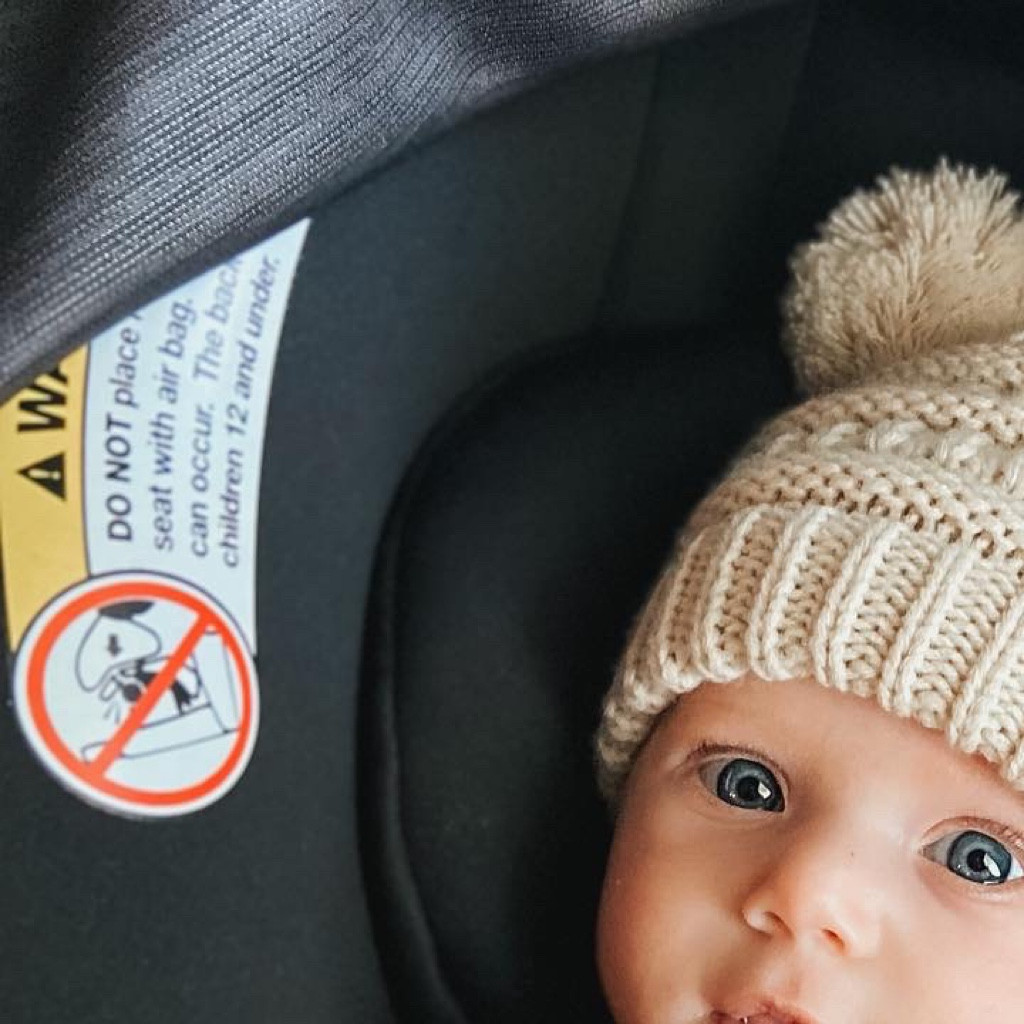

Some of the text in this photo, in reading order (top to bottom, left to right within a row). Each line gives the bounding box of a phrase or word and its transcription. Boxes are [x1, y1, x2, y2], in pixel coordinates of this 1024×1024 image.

[109, 325, 141, 409] place
[192, 329, 223, 382] The
[105, 413, 132, 483] NOT
[147, 299, 197, 552] seat with air bag.
[190, 403, 214, 493] occur.
[218, 256, 281, 568] children 12 and under.
[107, 494, 133, 542] DO
[190, 504, 210, 558] can
